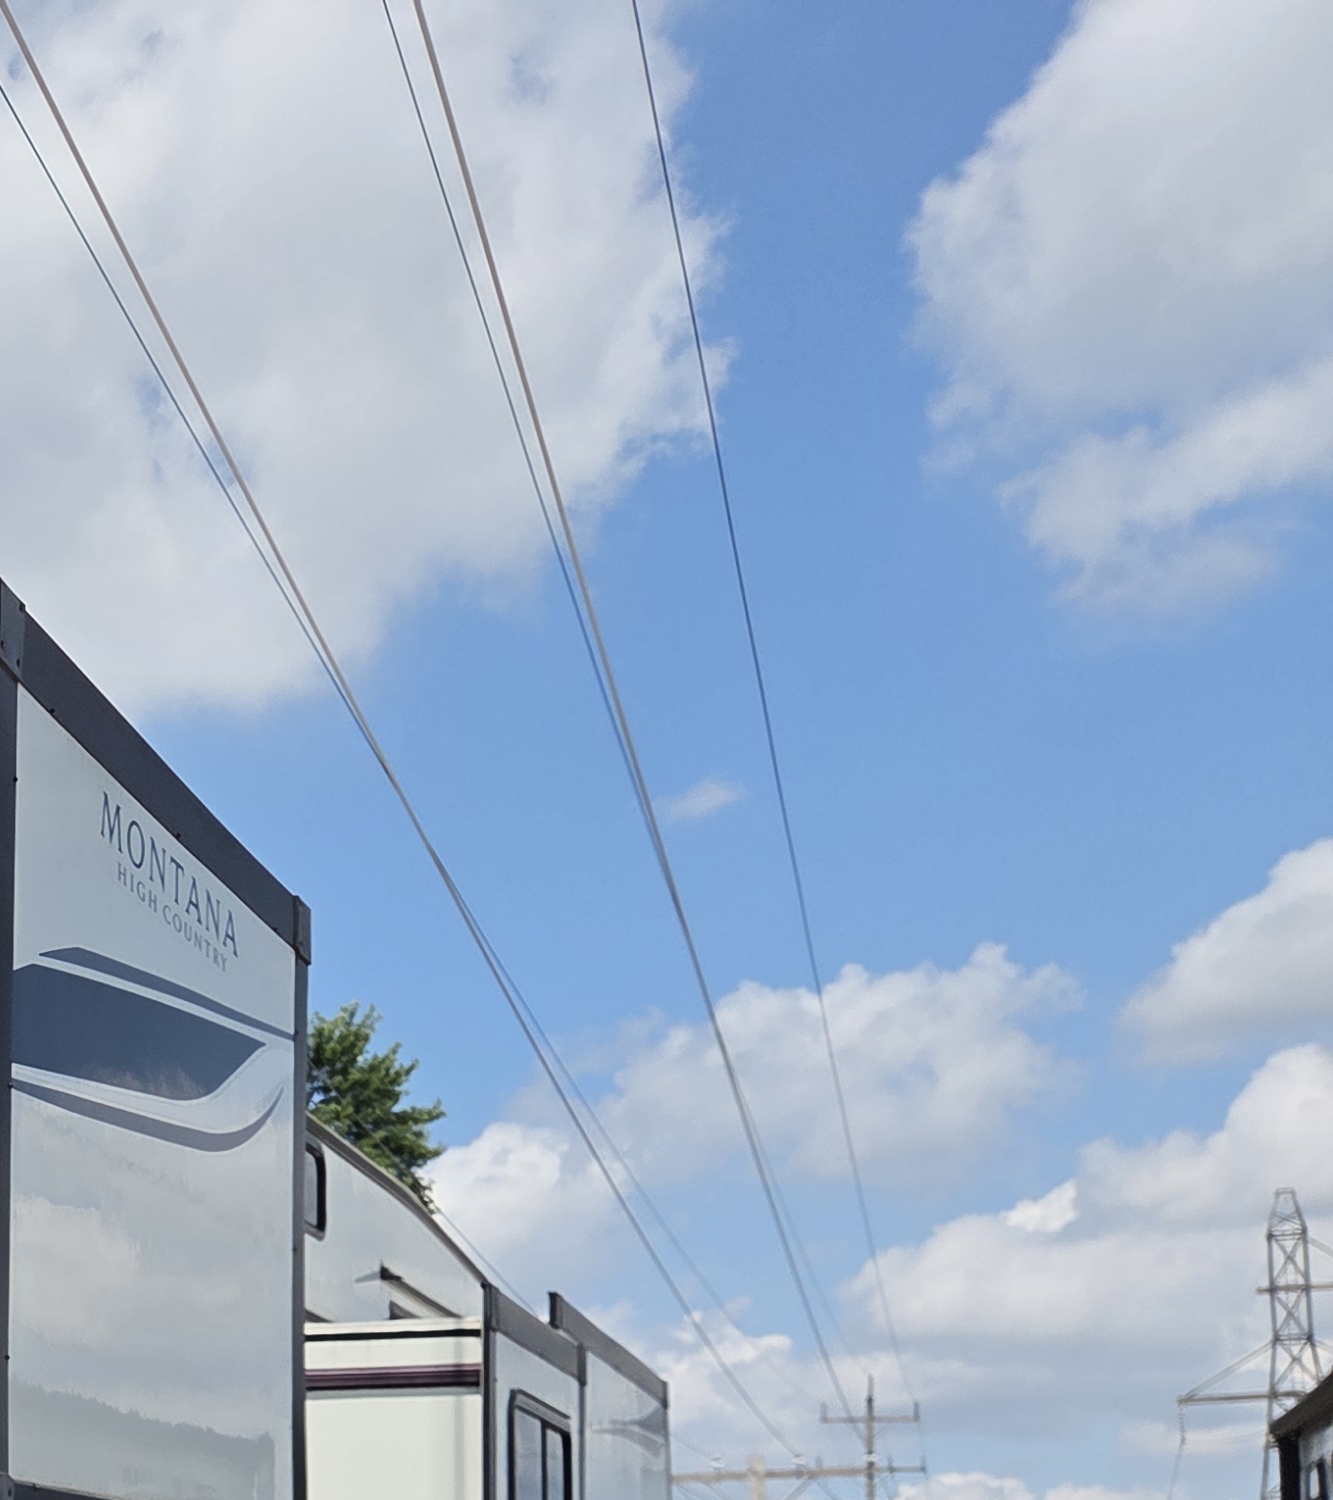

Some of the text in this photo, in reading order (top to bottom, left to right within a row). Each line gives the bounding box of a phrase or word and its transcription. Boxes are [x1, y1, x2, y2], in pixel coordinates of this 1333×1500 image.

[100, 791, 238, 958] MONTANA
[117, 862, 228, 973] HIGH COUNTRY
